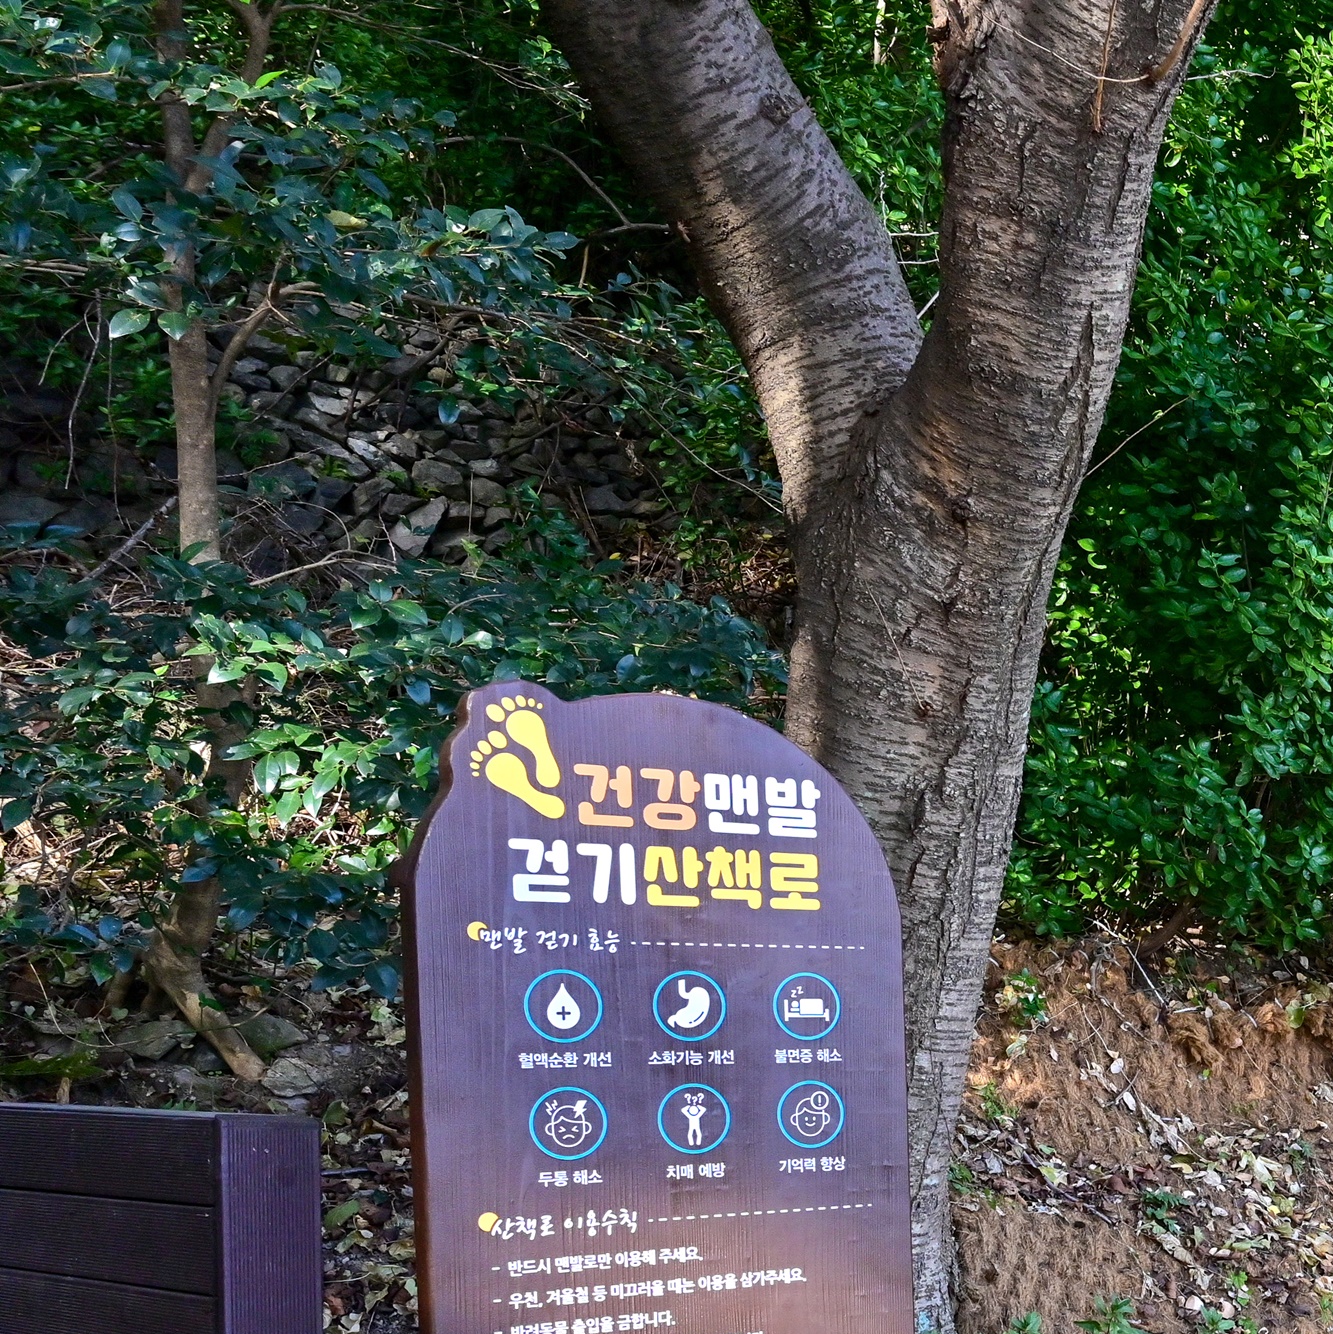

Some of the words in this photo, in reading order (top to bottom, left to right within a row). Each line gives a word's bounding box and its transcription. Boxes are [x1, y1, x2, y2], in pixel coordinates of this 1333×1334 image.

[480, 926, 527, 954] 맨발
[535, 929, 578, 951] 걷기
[587, 927, 621, 954] 효능
[518, 1052, 578, 1069] 혈액순환
[583, 1051, 612, 1068] 개선
[648, 1050, 703, 1066] 소화기능
[707, 1049, 735, 1065] 개선
[774, 1048, 813, 1063] 불면증
[817, 1048, 842, 1063] 해소
[666, 1164, 694, 1180] 치매
[698, 1162, 726, 1178] 예방
[778, 1157, 816, 1173] 기억력
[820, 1156, 845, 1172] 향상
[538, 1170, 568, 1187] 두통
[572, 1169, 603, 1186] 해소
[491, 1214, 555, 1240] 산책로
[564, 1208, 638, 1237] 이용수칙
[508, 1258, 551, 1277] 반드시
[555, 1253, 612, 1273] 맨발로만
[615, 1249, 656, 1267] 이용해
[659, 1246, 703, 1264] 주세요.
[509, 1291, 543, 1309] 우천,
[546, 1286, 589, 1306] 겨울철
[592, 1285, 608, 1302] 등
[610, 1280, 665, 1299] 미끄러울
[667, 1278, 695, 1294] 때는
[698, 1273, 737, 1291] 이용을
[740, 1267, 807, 1287] 삼가주세요.
[617, 1310, 676, 1331] 금합니다.
